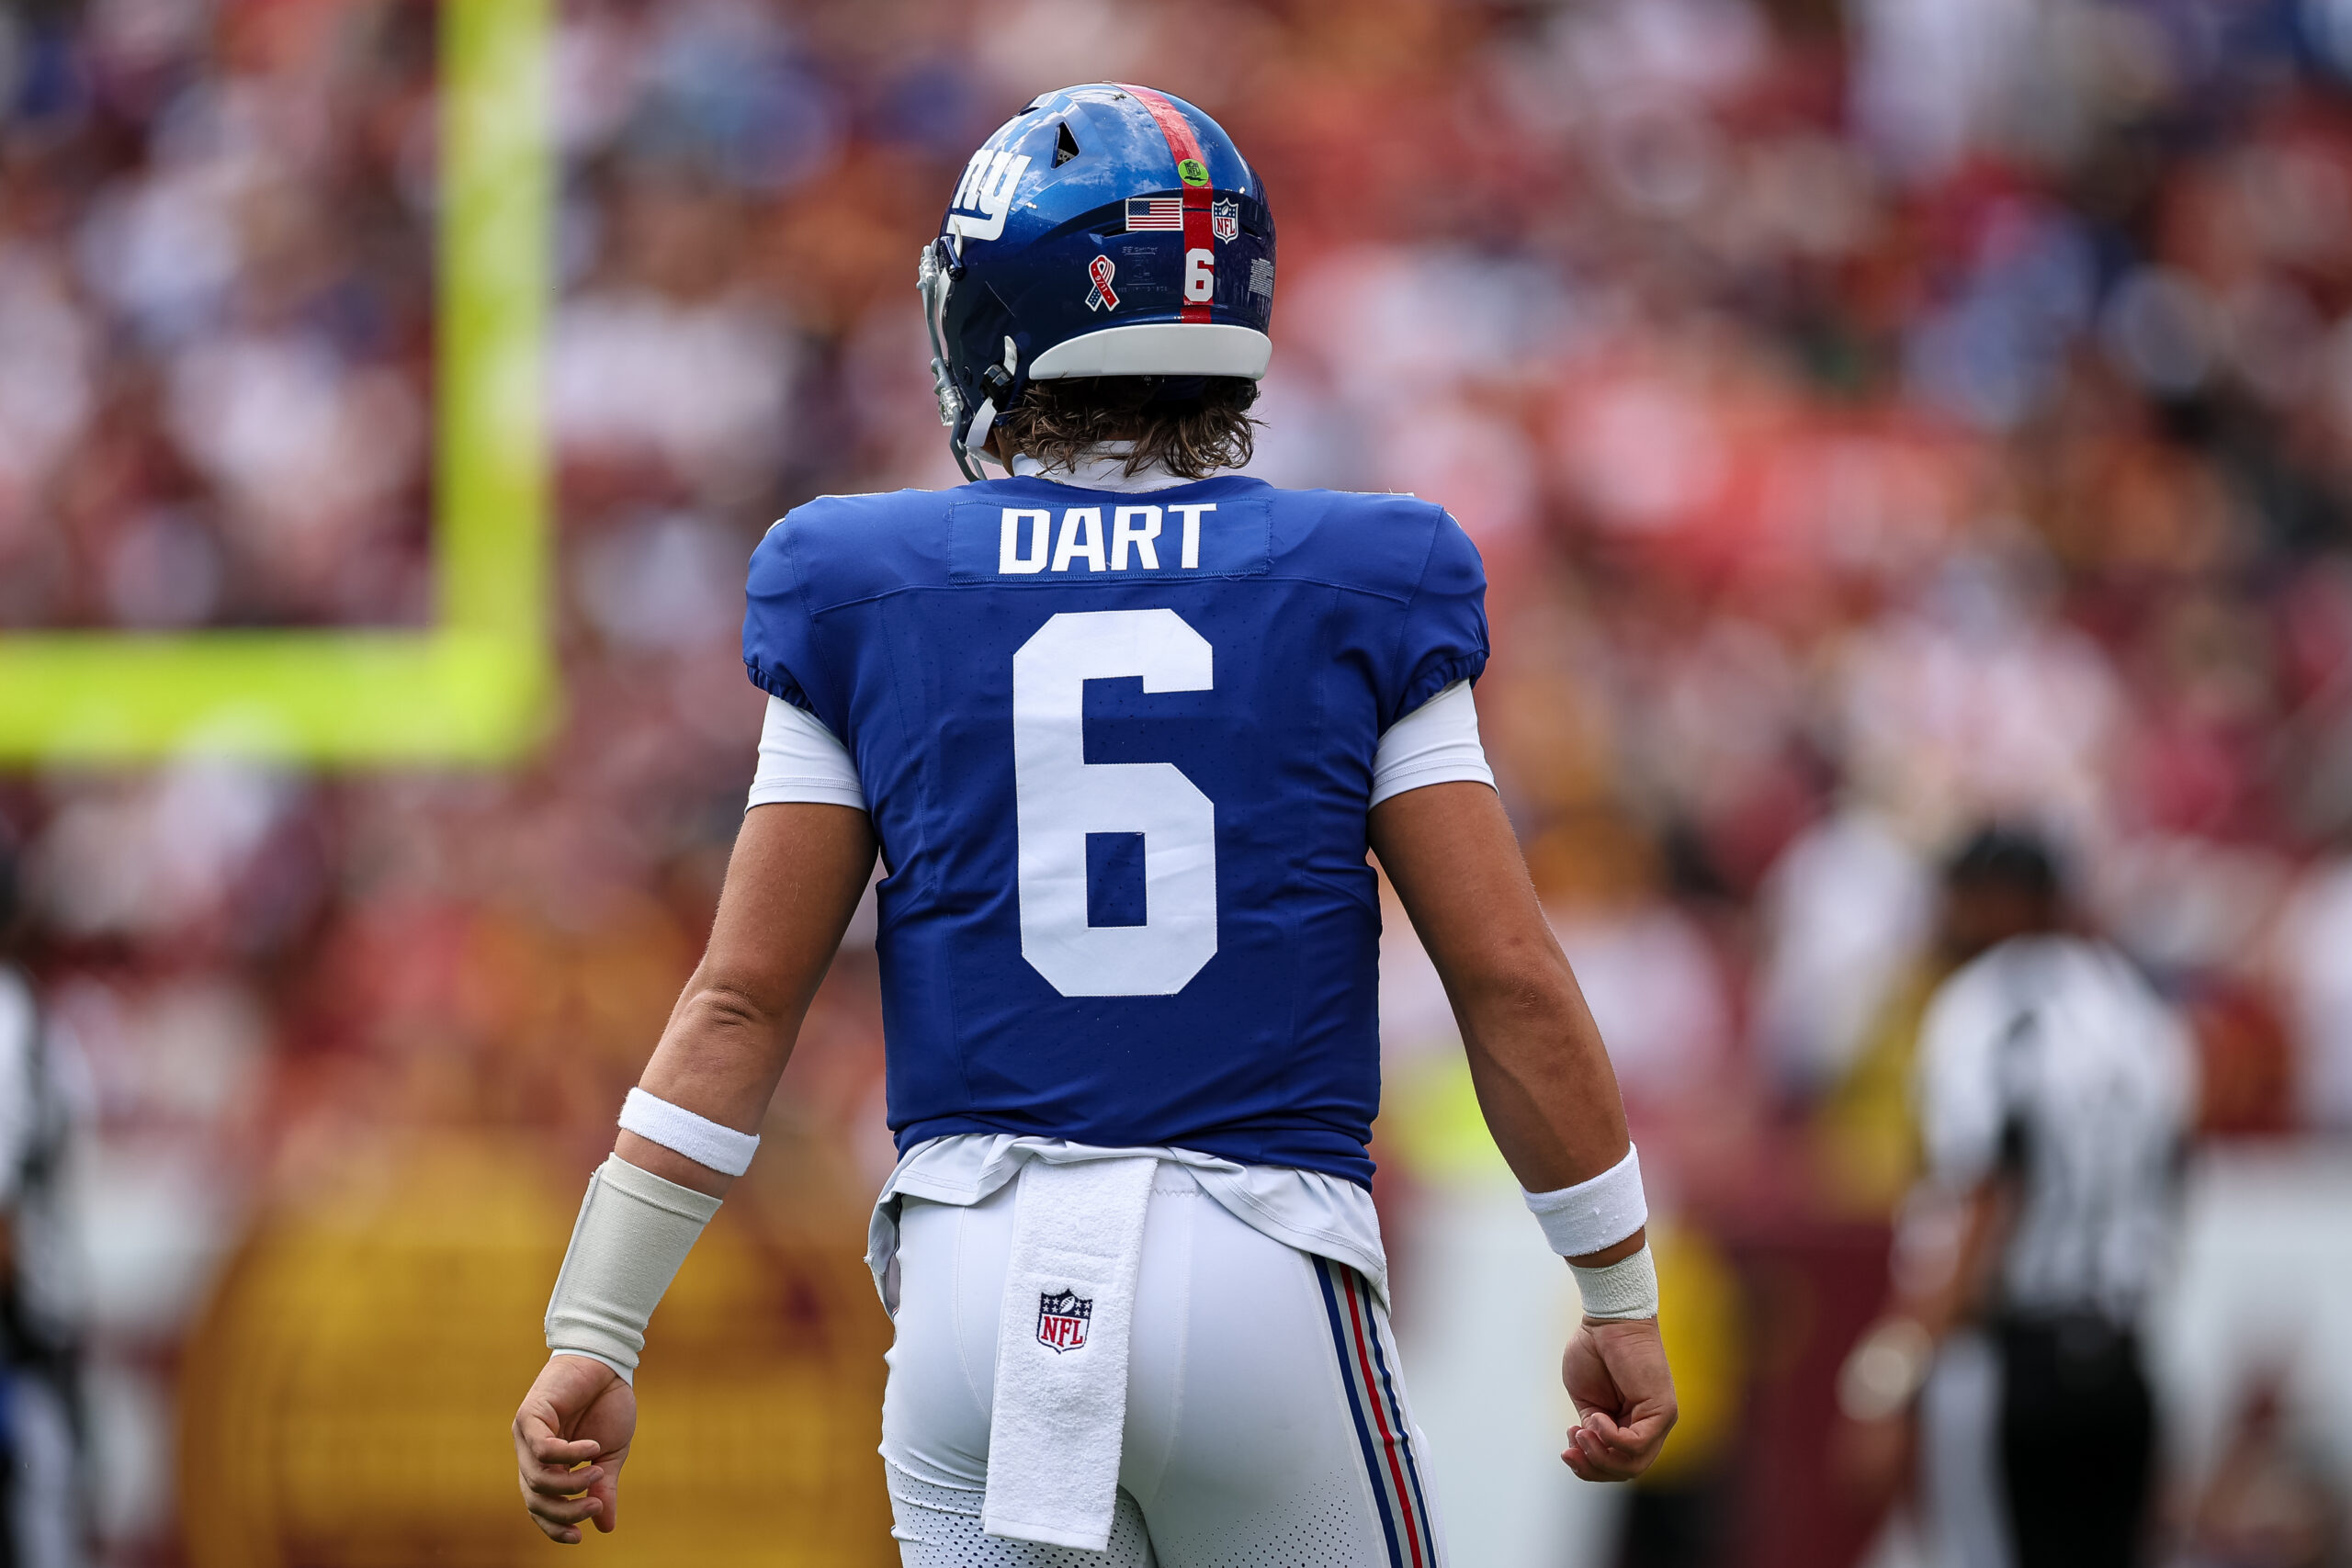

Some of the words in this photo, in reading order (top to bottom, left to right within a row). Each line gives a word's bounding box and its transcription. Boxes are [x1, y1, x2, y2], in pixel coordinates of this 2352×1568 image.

[1216, 218, 1236, 237] NFL
[1095, 275, 1108, 293] 9/11
[1184, 248, 1215, 302] 6
[999, 502, 1217, 575] DART
[1012, 607, 1218, 998] 6
[1040, 1315, 1084, 1348] NFL
